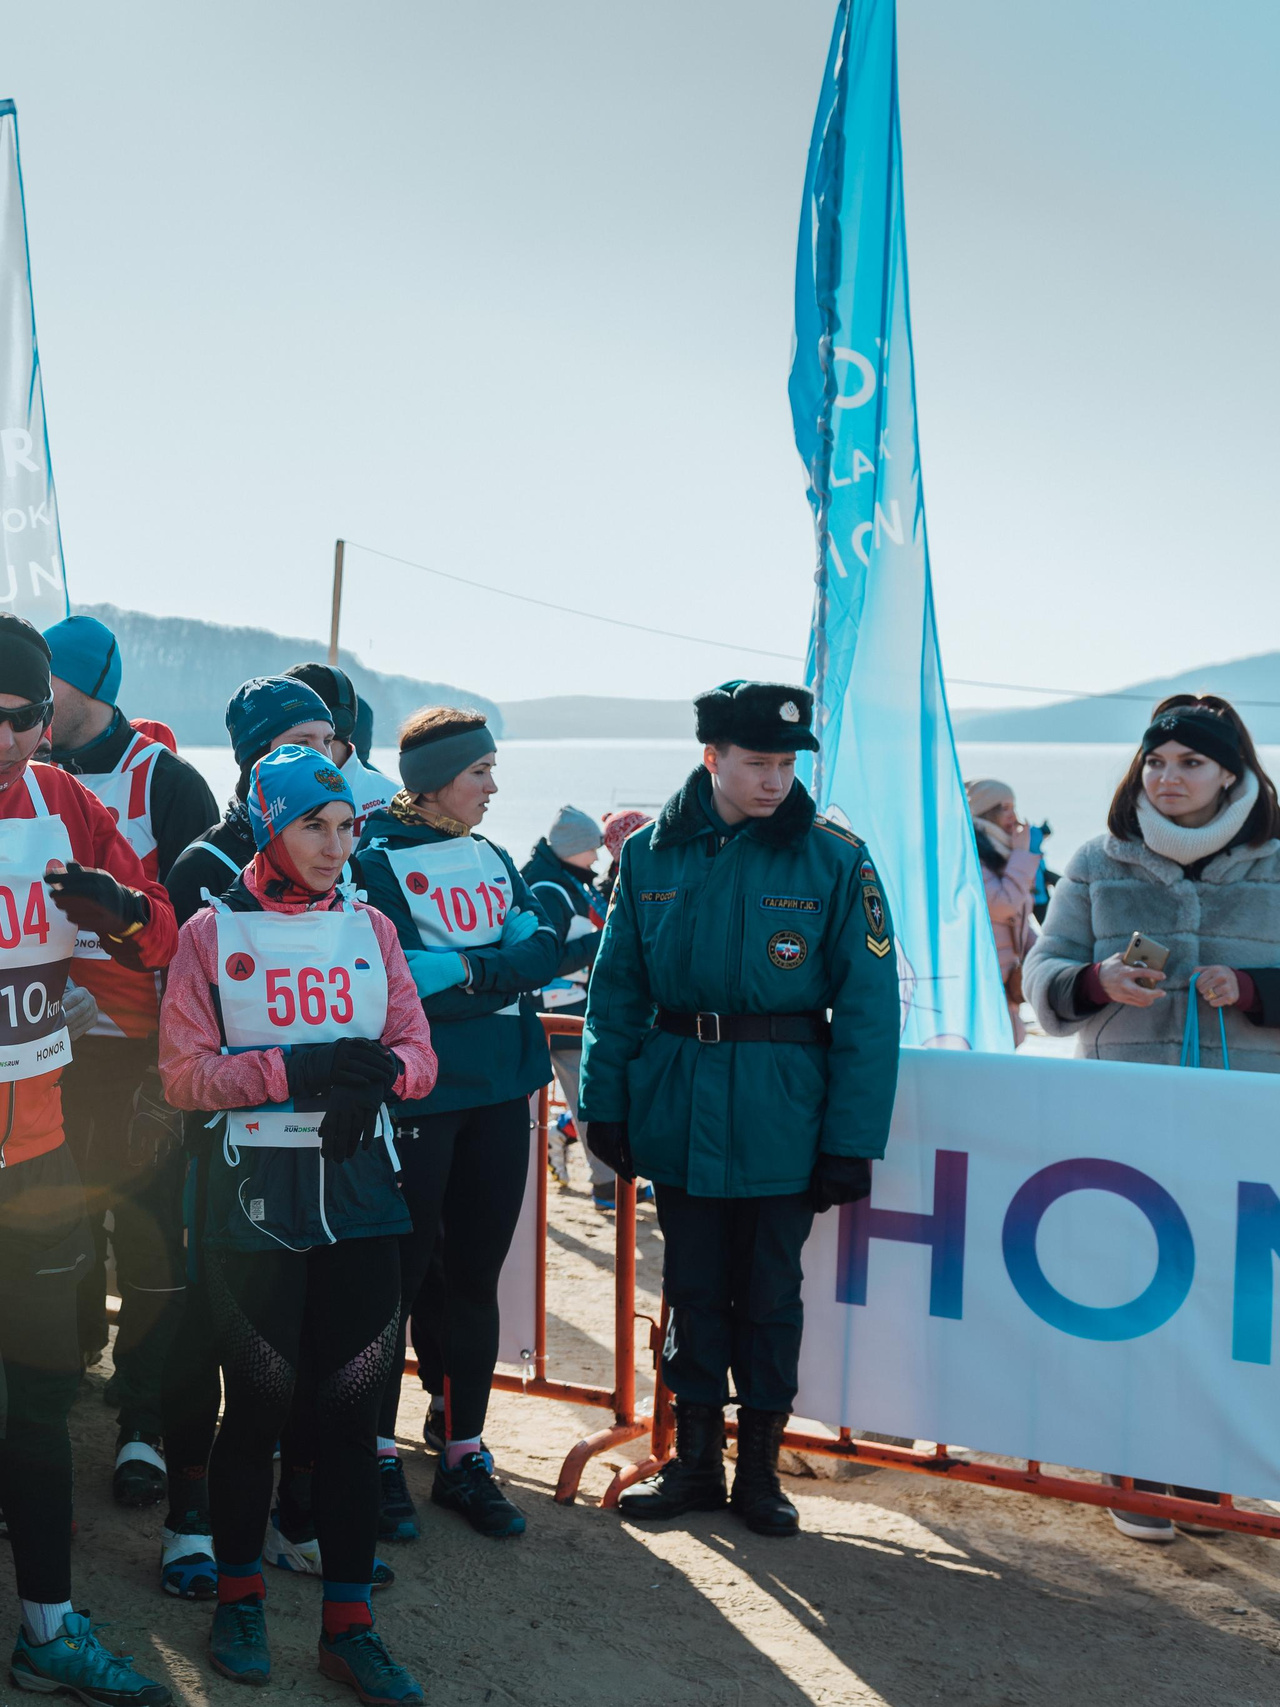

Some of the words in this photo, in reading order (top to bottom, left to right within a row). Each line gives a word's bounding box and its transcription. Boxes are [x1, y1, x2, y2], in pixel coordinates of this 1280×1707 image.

[413, 877, 424, 890] A
[765, 898, 798, 909] ГАГАРИН
[74, 938, 103, 949] ONOR
[233, 959, 249, 975] A
[0, 981, 48, 1028] 10
[46, 1000, 60, 1019] km
[265, 966, 354, 1028] 563
[36, 1041, 65, 1062] HONOR
